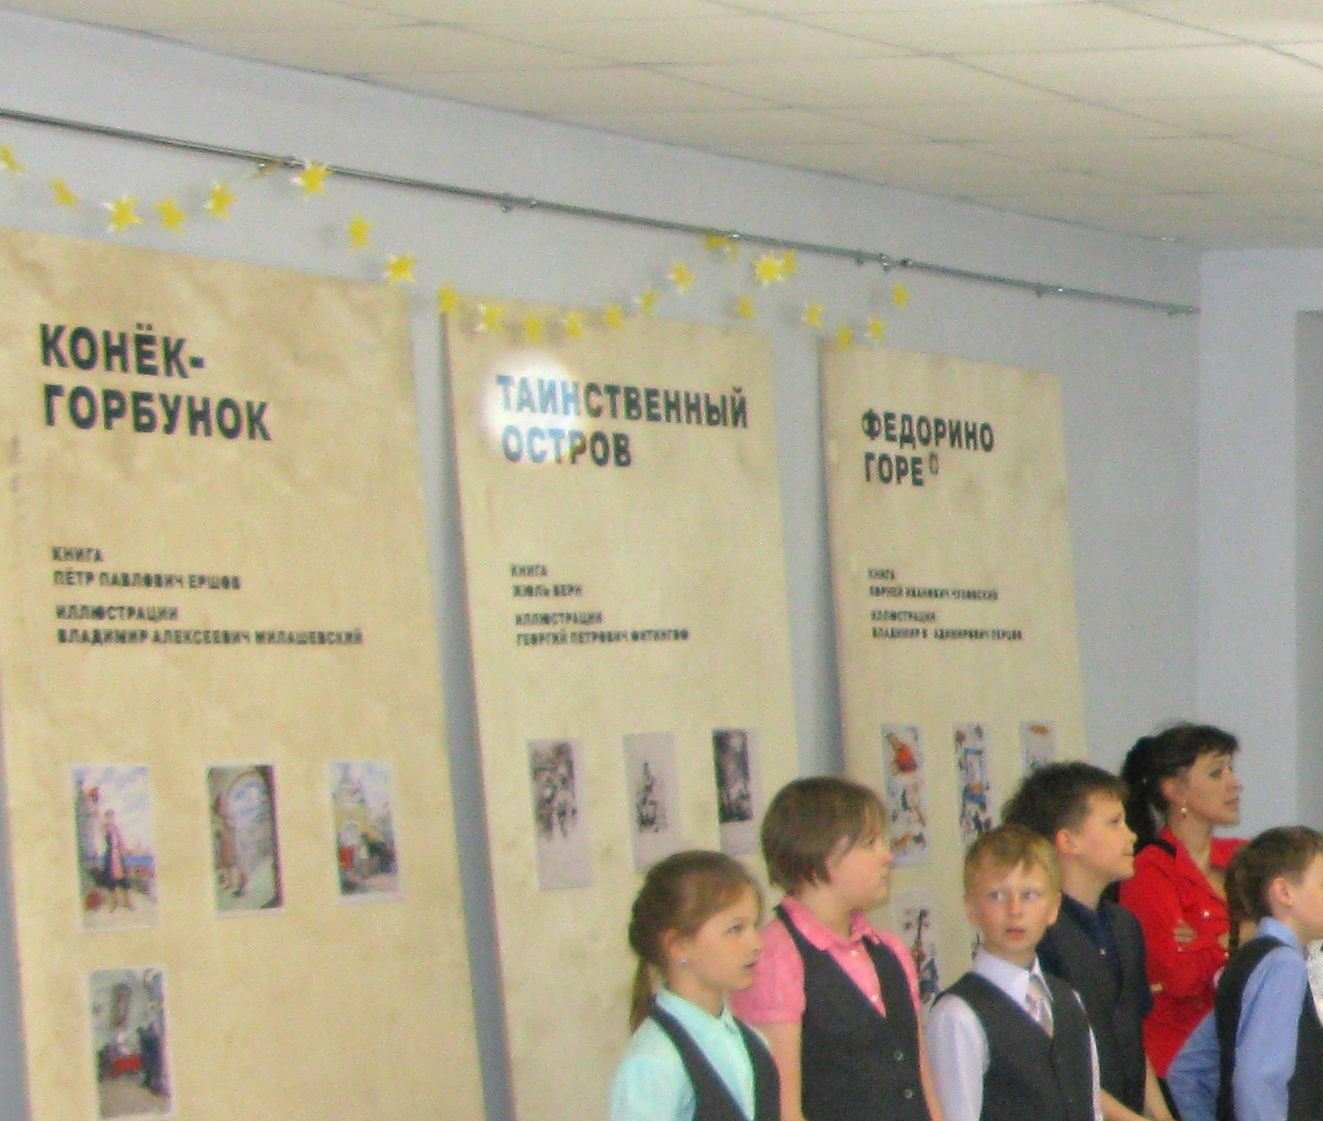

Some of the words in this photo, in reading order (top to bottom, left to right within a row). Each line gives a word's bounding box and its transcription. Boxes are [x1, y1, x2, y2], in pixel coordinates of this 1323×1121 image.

[39, 322, 205, 379] КОНЁК-
[42, 384, 272, 441] ГОРБУНОК
[495, 373, 749, 429] ТАИНСТВЕННЫЙ
[501, 425, 632, 468] ОСТРОВ
[861, 408, 995, 452] ФЕДОРИНО
[864, 451, 925, 487] ГОРЕ
[52, 546, 104, 562] КНИГА
[55, 604, 179, 622] ИЛЛЮСТРАЦИИ
